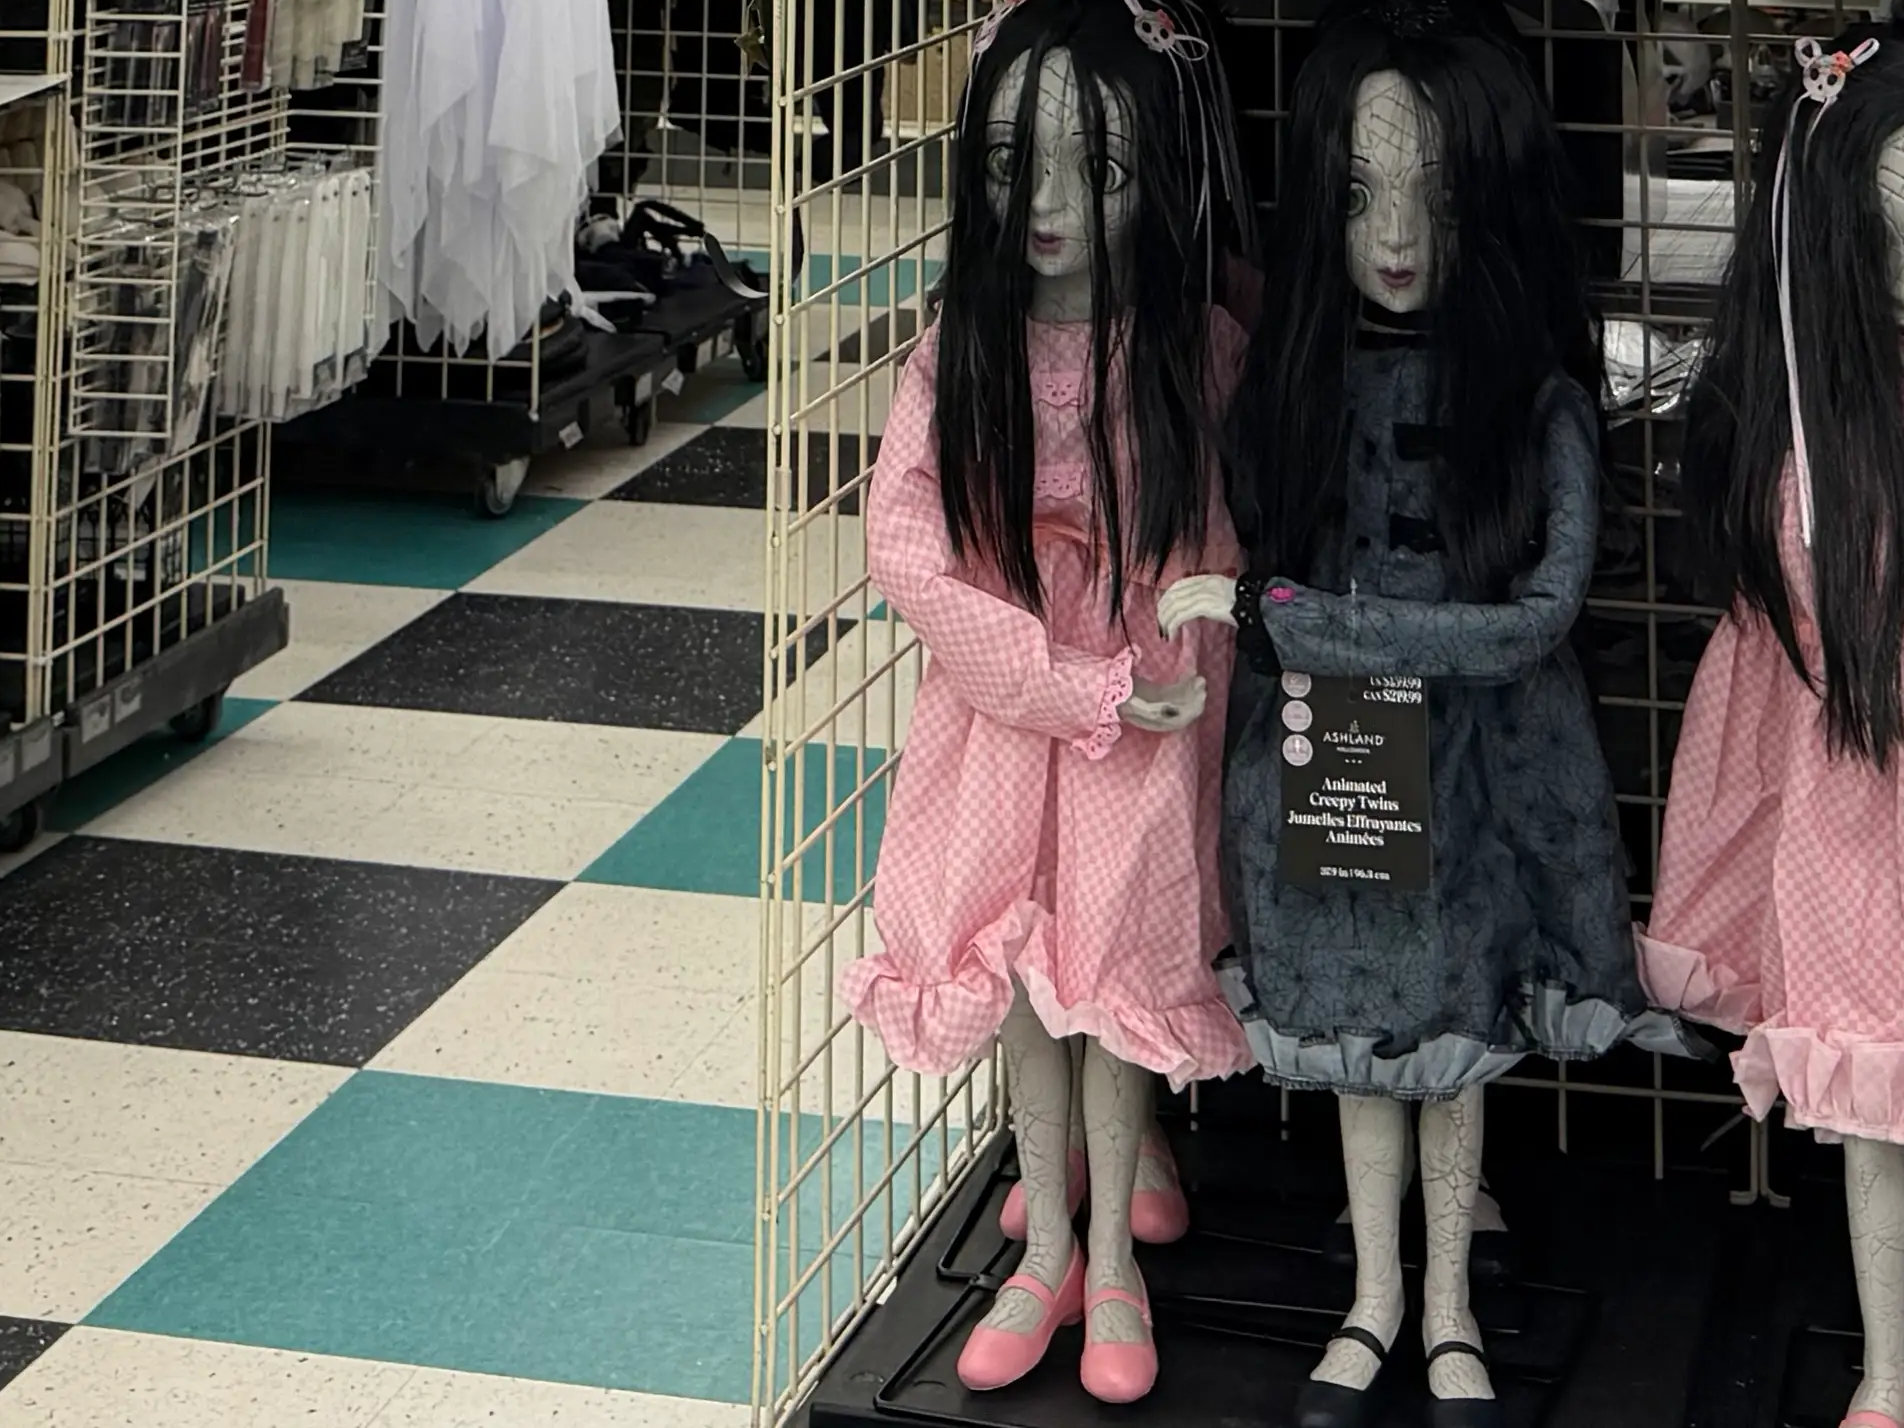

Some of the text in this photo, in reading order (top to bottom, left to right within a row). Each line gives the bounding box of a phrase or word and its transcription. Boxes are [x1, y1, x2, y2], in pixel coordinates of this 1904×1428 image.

[1323, 732, 1384, 746] ASHLAND
[1322, 777, 1387, 794] Animated
[1309, 792, 1399, 811] Creepy Twins
[1287, 810, 1422, 833] Jumelles Effrayantes
[1325, 830, 1384, 846] Animées
